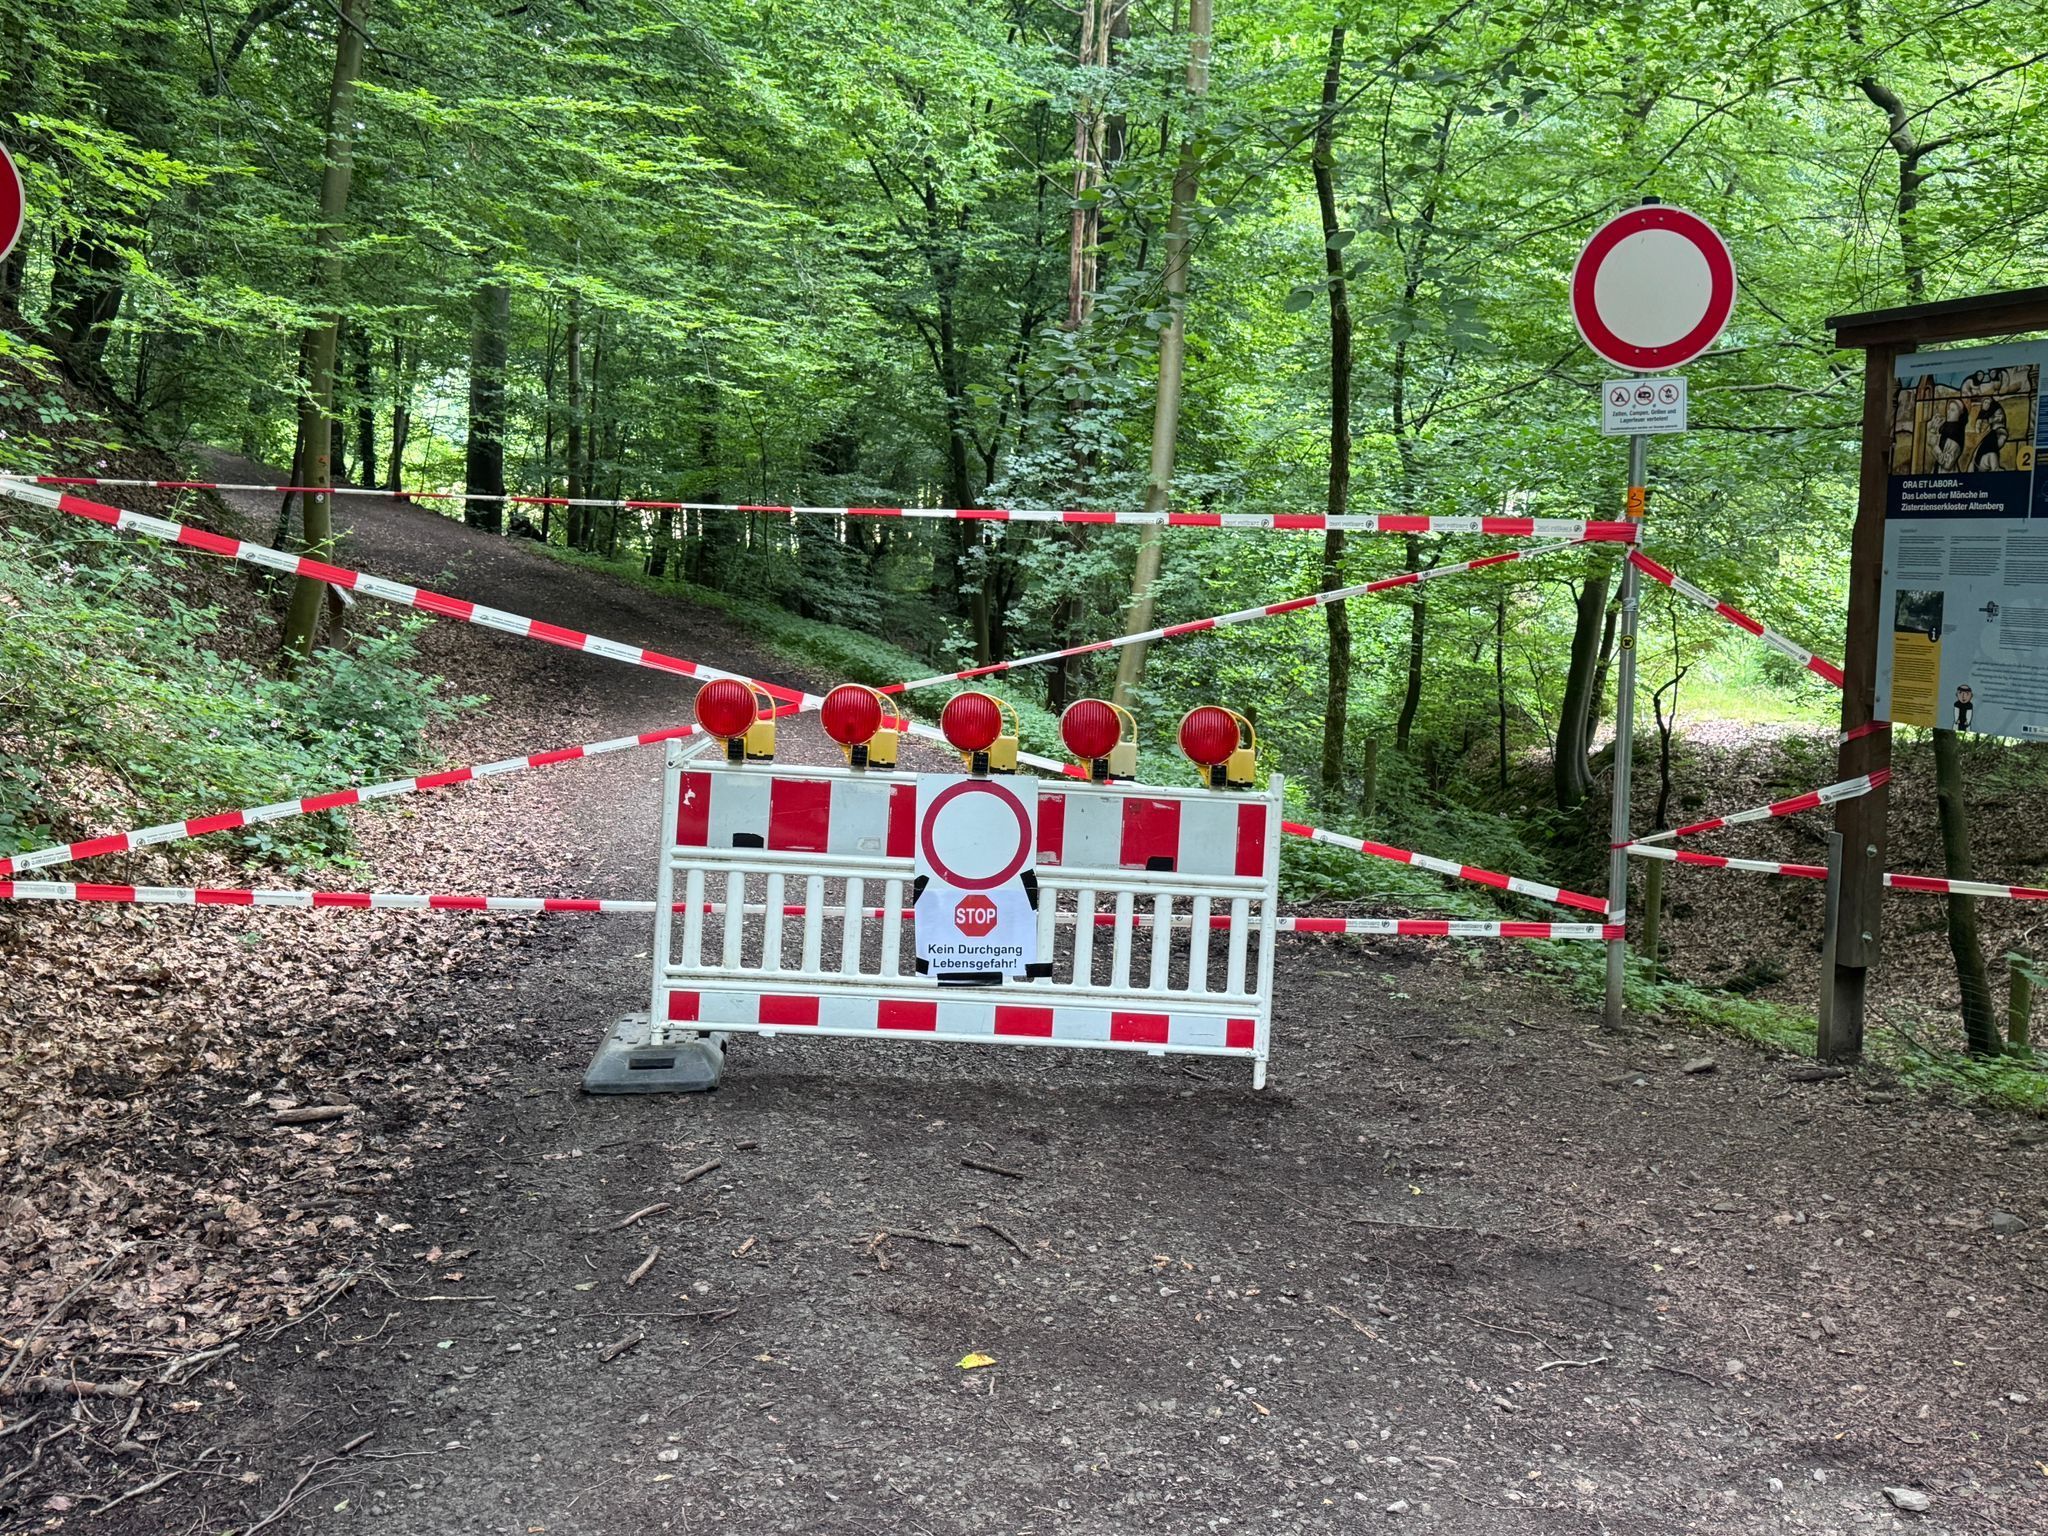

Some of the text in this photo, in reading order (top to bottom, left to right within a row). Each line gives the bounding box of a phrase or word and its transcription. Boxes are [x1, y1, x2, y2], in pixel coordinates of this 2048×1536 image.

[2022, 452, 2031, 466] 2
[1902, 480, 1917, 489] ORA
[1918, 480, 1928, 488] ET
[1928, 479, 1958, 488] LABORA
[1901, 490, 1988, 500] Das Leben der Mönche im
[1901, 502, 2004, 512] Zisterzienserkloster Altenberg
[956, 907, 996, 924] STOP
[928, 944, 1023, 957] Kein Durchgang
[932, 958, 1017, 969] Lebensgefahr!
